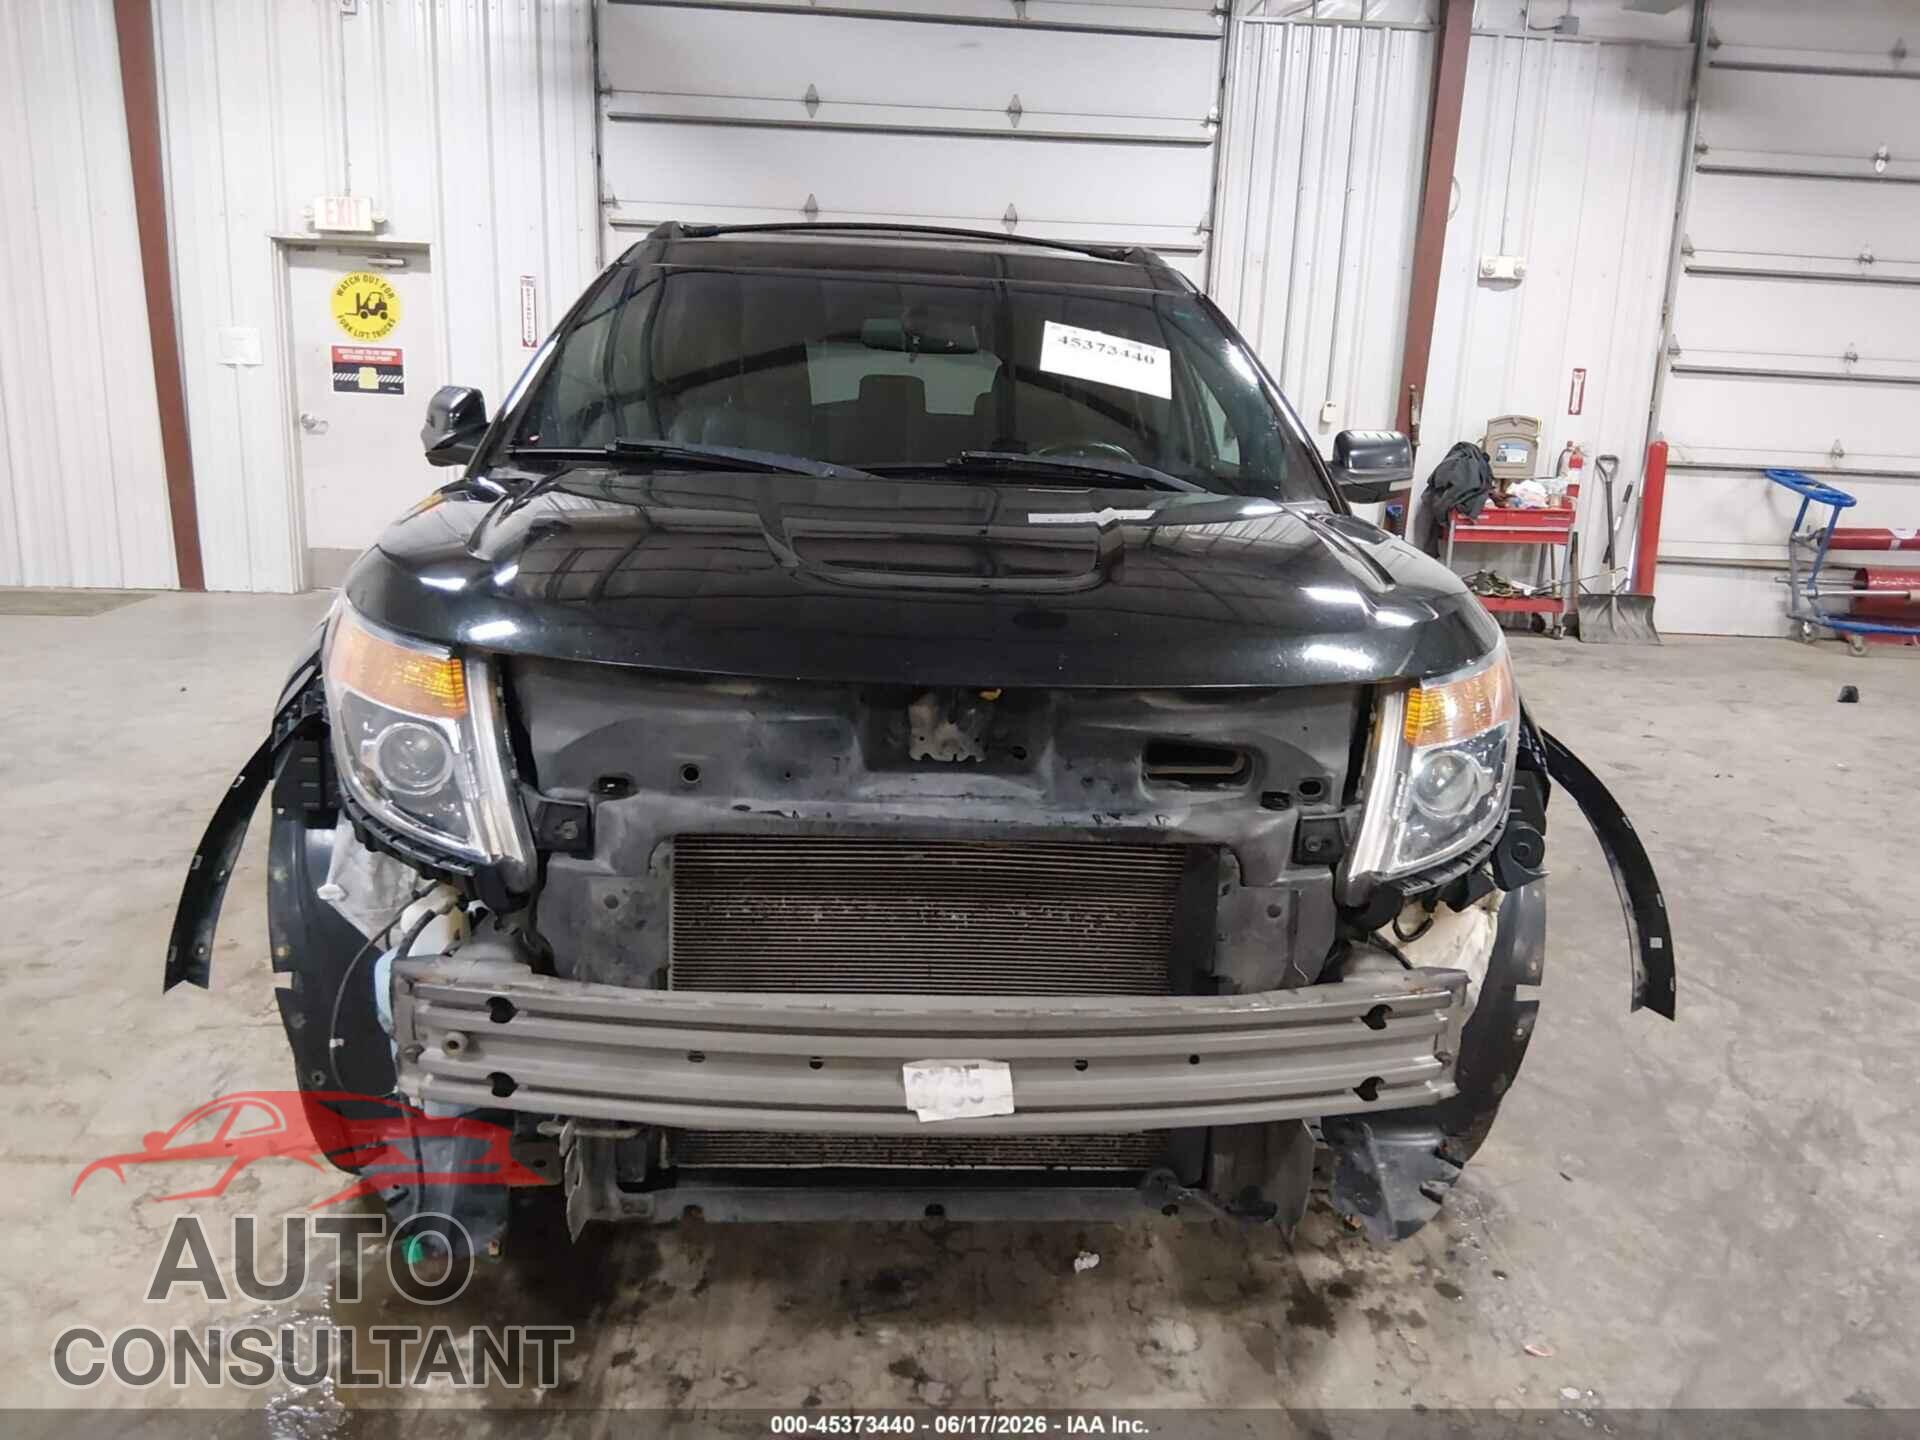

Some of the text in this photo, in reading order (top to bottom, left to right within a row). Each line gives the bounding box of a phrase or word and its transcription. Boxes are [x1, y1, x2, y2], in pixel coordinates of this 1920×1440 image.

[324, 198, 363, 226] EXIT
[336, 274, 395, 299] WATCH OUT FOR
[336, 313, 396, 339] FORK LIFT TRUCKS
[1057, 335, 1155, 365] 45373440
